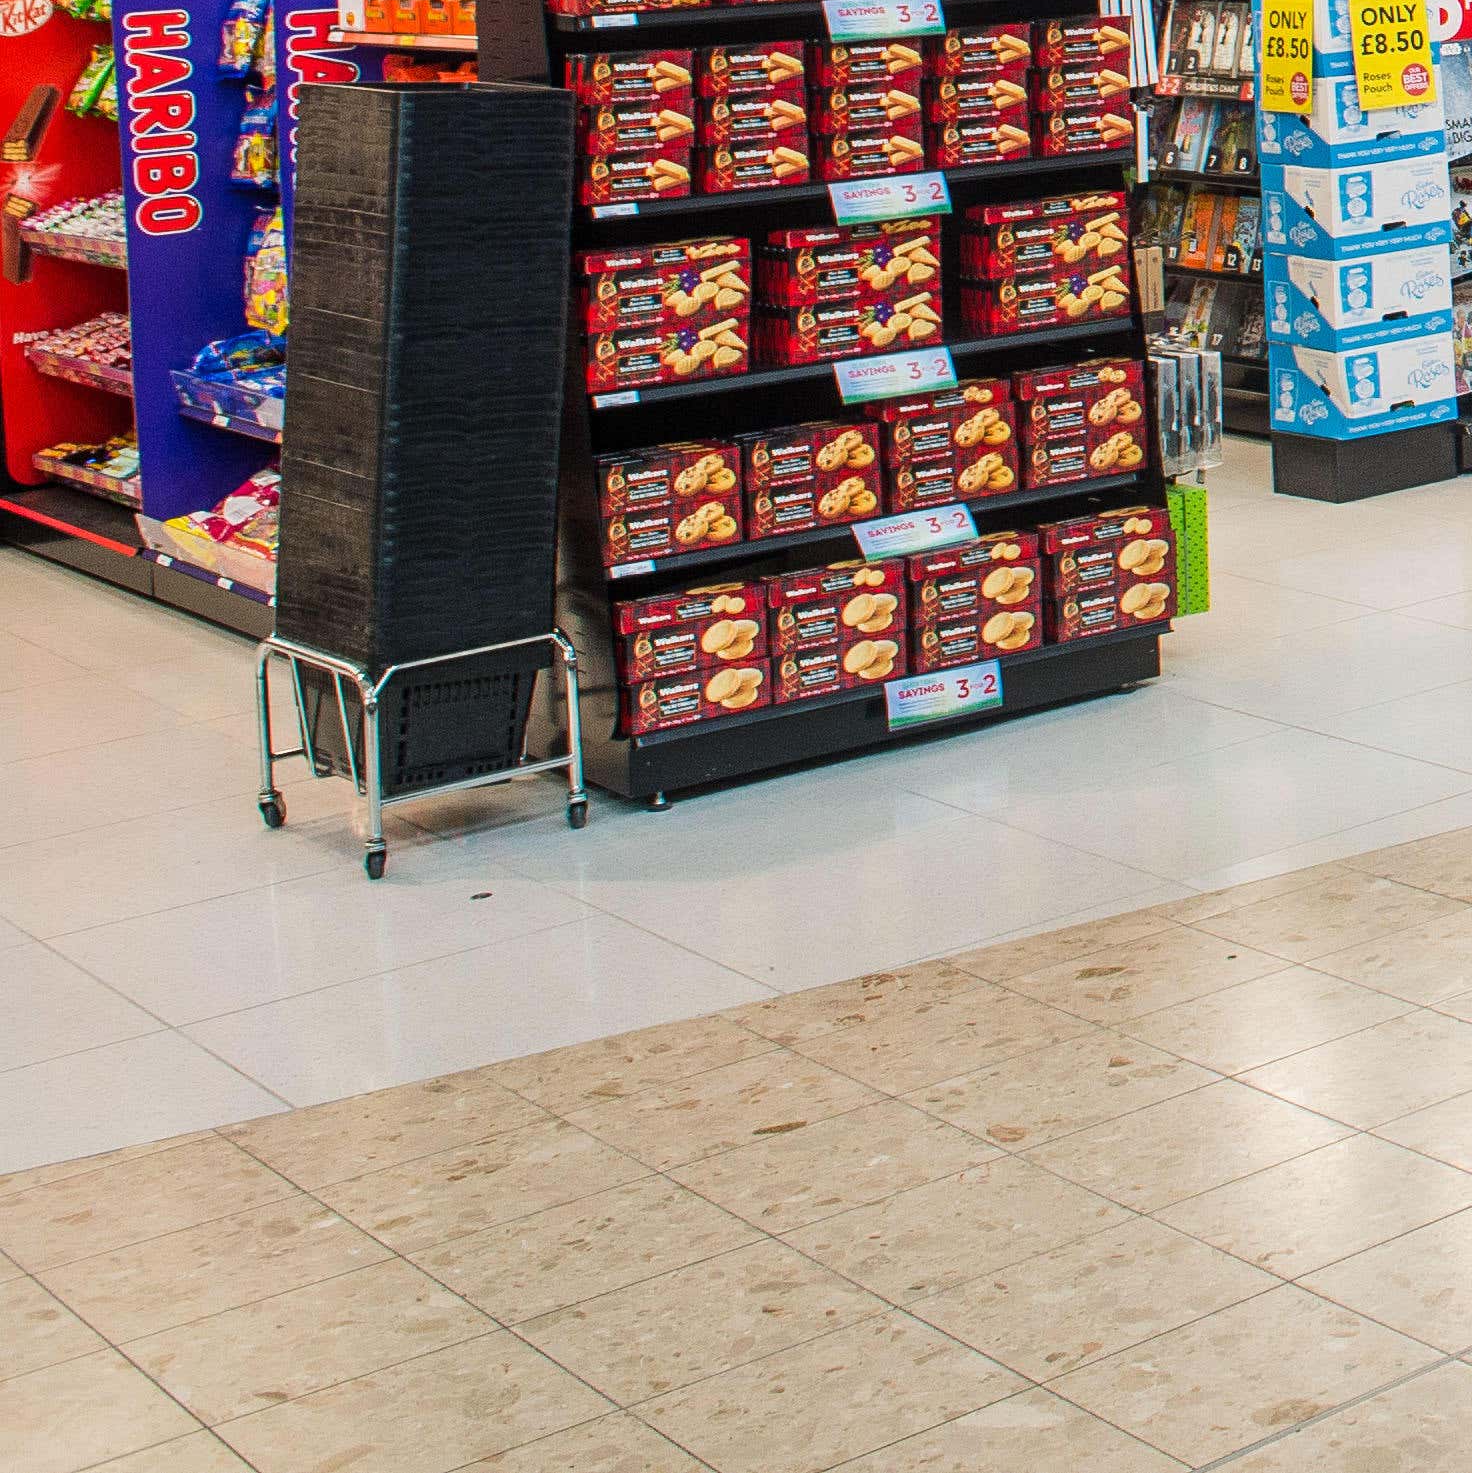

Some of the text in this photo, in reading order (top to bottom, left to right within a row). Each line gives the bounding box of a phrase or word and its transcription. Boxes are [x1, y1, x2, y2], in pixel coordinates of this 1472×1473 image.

[2, 0, 46, 33] KitKat
[838, 4, 938, 22] SAVINGS 3 2
[1361, 4, 1417, 26] ONLY
[1269, 11, 1307, 29] ONLY
[1267, 36, 1309, 59] £8.50
[1361, 30, 1424, 56] £8.50
[1363, 72, 1392, 82] Roses
[1402, 72, 1429, 84] BEST
[1266, 87, 1285, 96] Pouch
[1291, 82, 1308, 92] BEST
[1363, 83, 1393, 94] Pouch
[122, 9, 203, 236] HARIBO
[1452, 130, 1472, 143] BIG
[620, 278, 663, 289] Walkers
[1049, 401, 1083, 411] Walkers
[627, 469, 670, 481] Walkers
[655, 633, 695, 646] Walkers
[898, 674, 998, 700] SAVINGS 3 2
